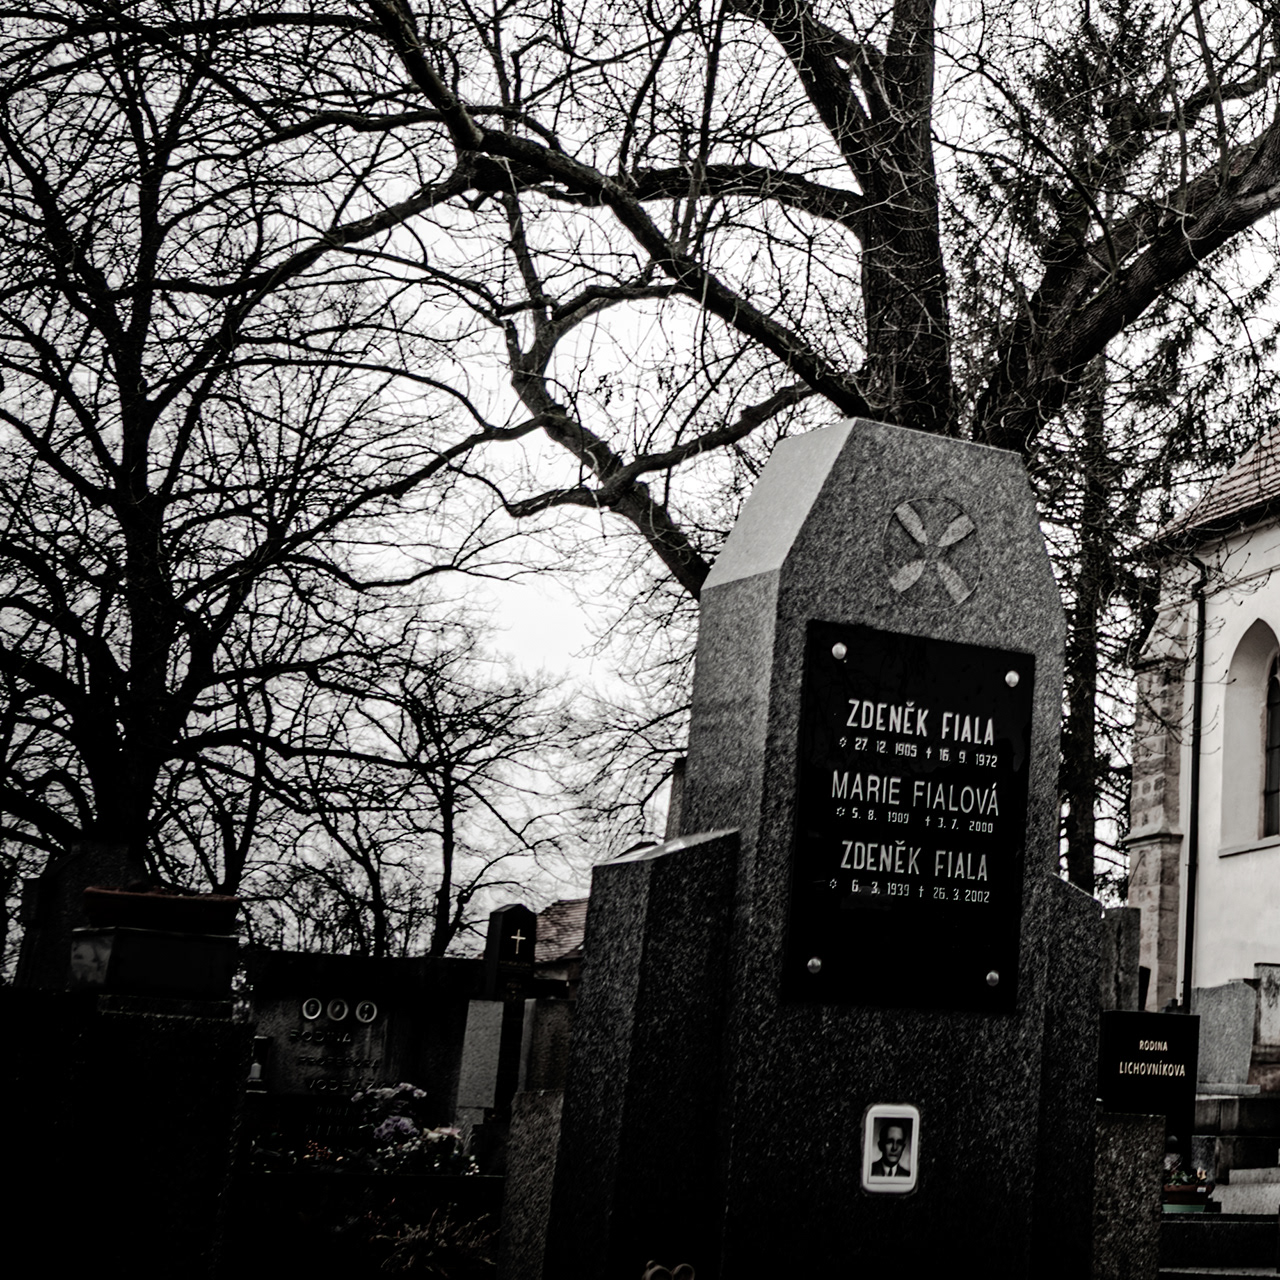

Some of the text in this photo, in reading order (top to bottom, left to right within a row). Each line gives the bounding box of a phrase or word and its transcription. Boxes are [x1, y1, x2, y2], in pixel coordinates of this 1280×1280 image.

[846, 699, 994, 746] ZDENĚK FIALA
[855, 737, 998, 768] 27. 12. 1905 16. 9. 1972
[832, 770, 999, 816] MARIE FIALOVÁ
[852, 807, 994, 833] 5. 8. 1909 3. 7. 2000
[841, 840, 988, 881] ZDENĚK FIALA
[852, 879, 861, 893] 6.
[871, 881, 880, 895] 3.
[887, 882, 910, 896] 1939
[933, 886, 949, 900] 26.
[964, 889, 990, 903] 2002
[1139, 1039, 1168, 1051] RODINA
[1119, 1060, 1186, 1077] LICHOVNÍKOVA
